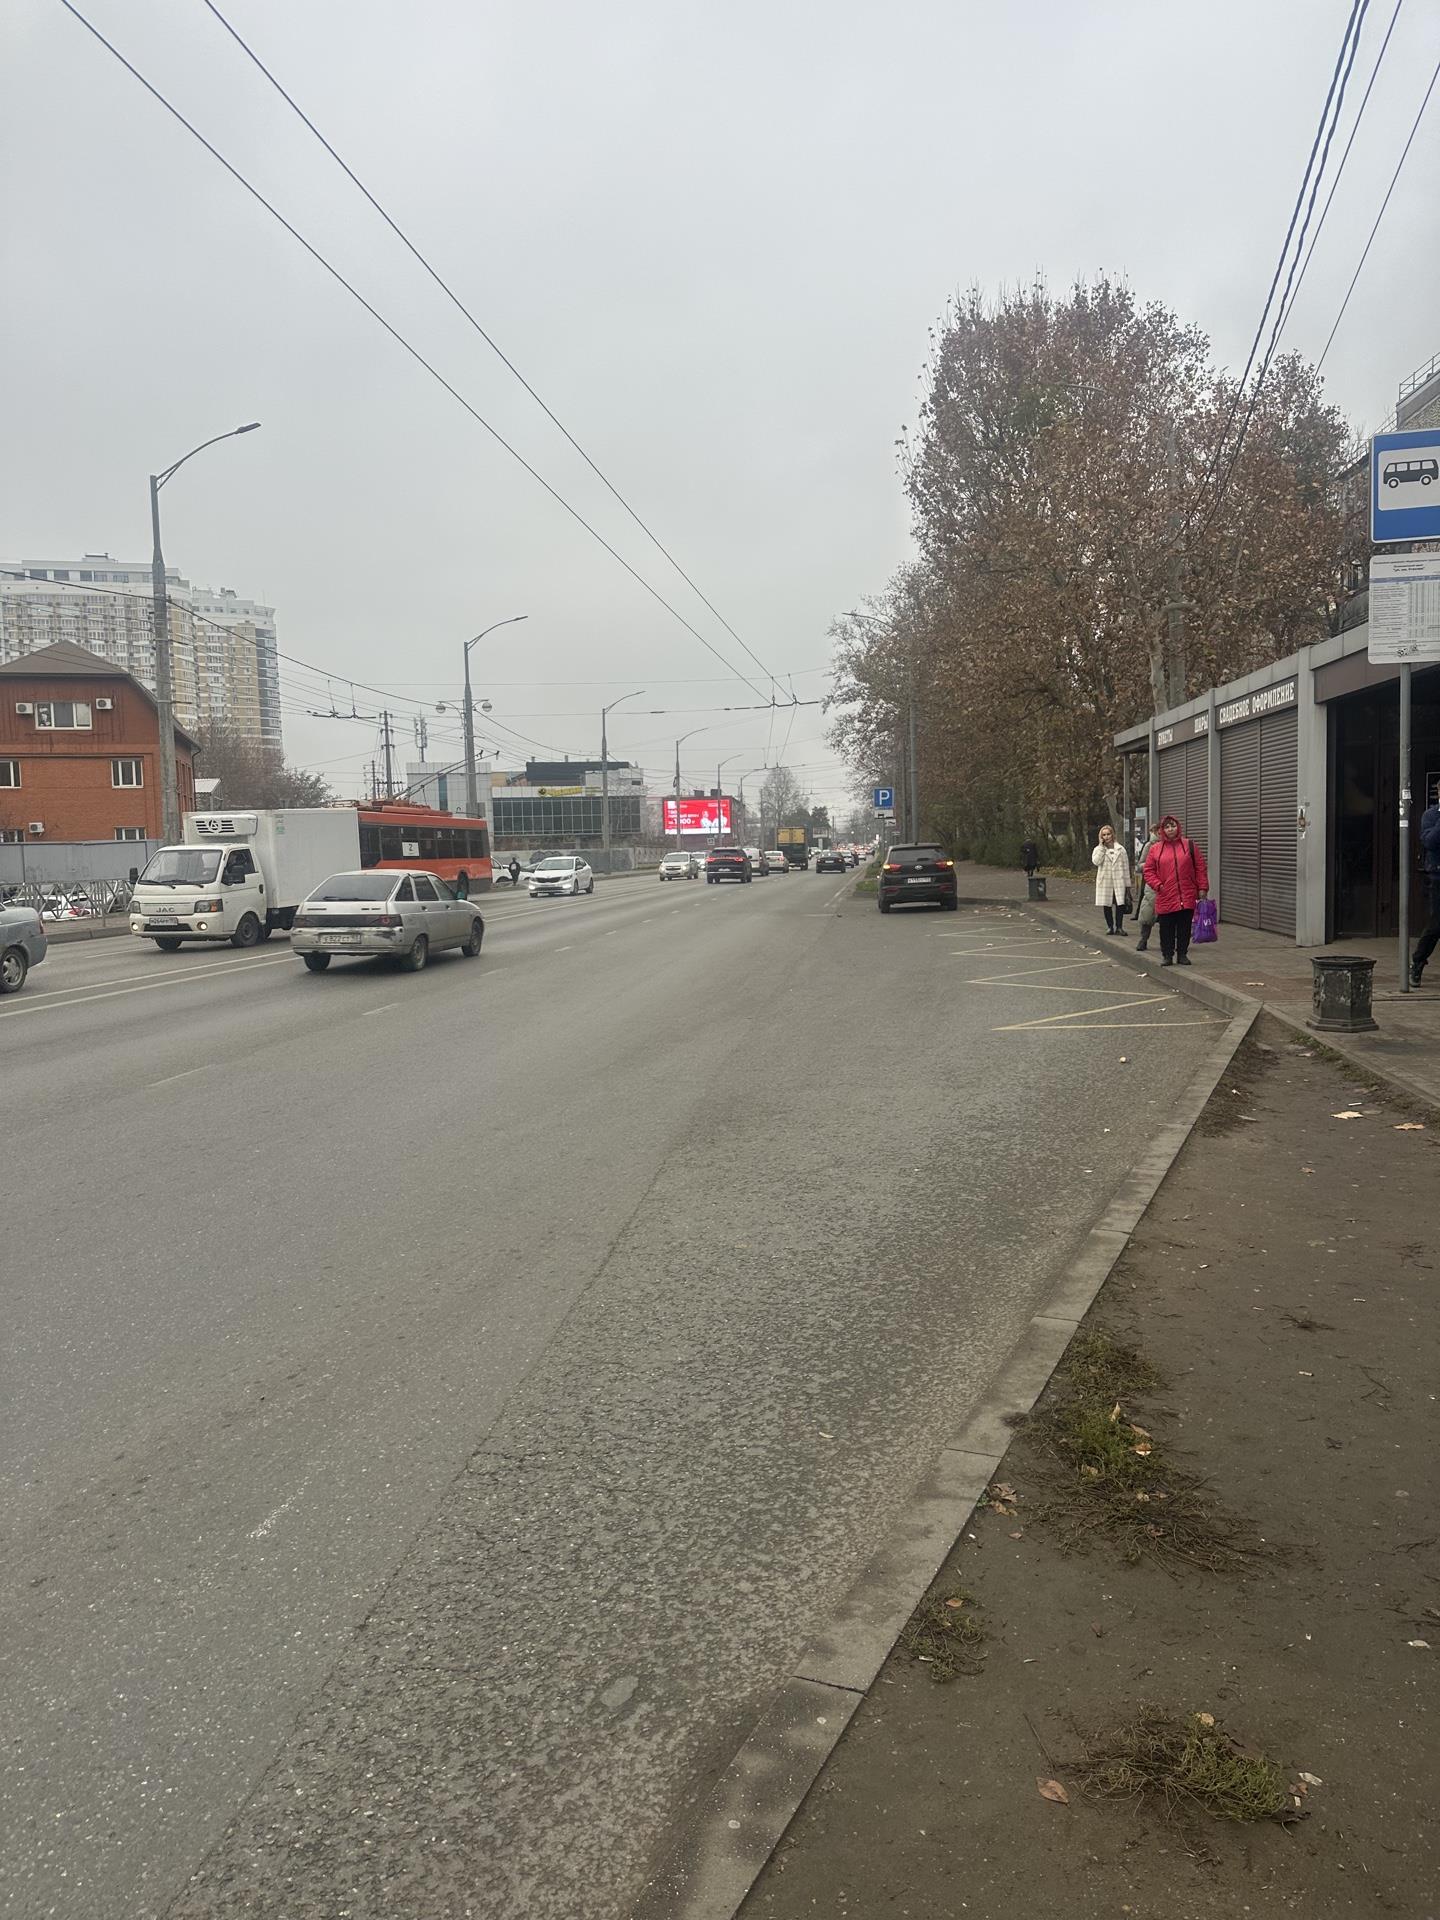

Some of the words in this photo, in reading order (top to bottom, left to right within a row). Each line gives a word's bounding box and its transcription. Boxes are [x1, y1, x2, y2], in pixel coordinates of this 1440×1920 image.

[1219, 698, 1250, 724] СВАДЕБНОЕ
[1252, 681, 1295, 713] ОФОРМЛЕНИЕ
[879, 790, 890, 805] P
